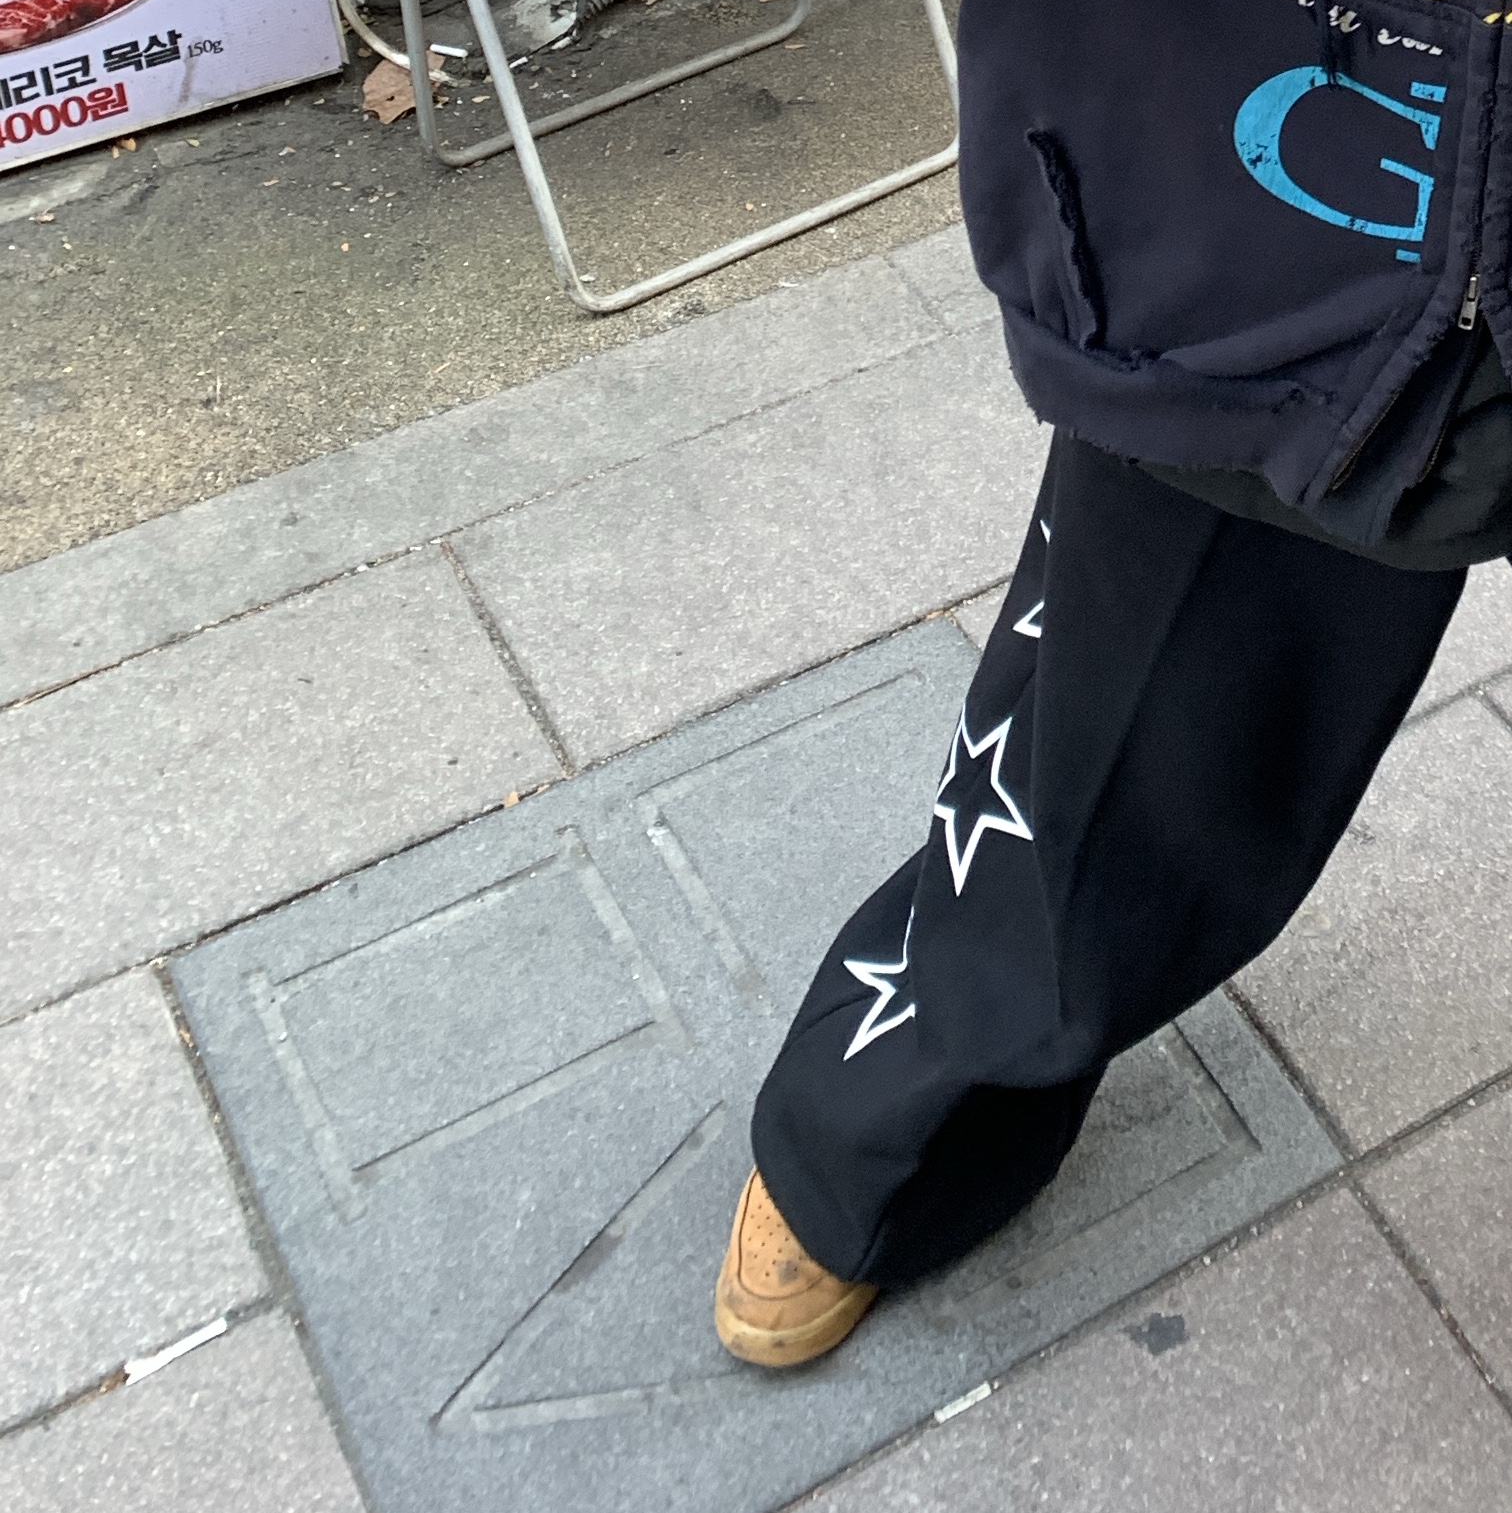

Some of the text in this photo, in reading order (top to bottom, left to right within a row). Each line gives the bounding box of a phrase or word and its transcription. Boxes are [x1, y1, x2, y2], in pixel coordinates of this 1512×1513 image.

[103, 29, 183, 73] 목살
[187, 39, 225, 59] 150g
[0, 82, 130, 148] 000원
